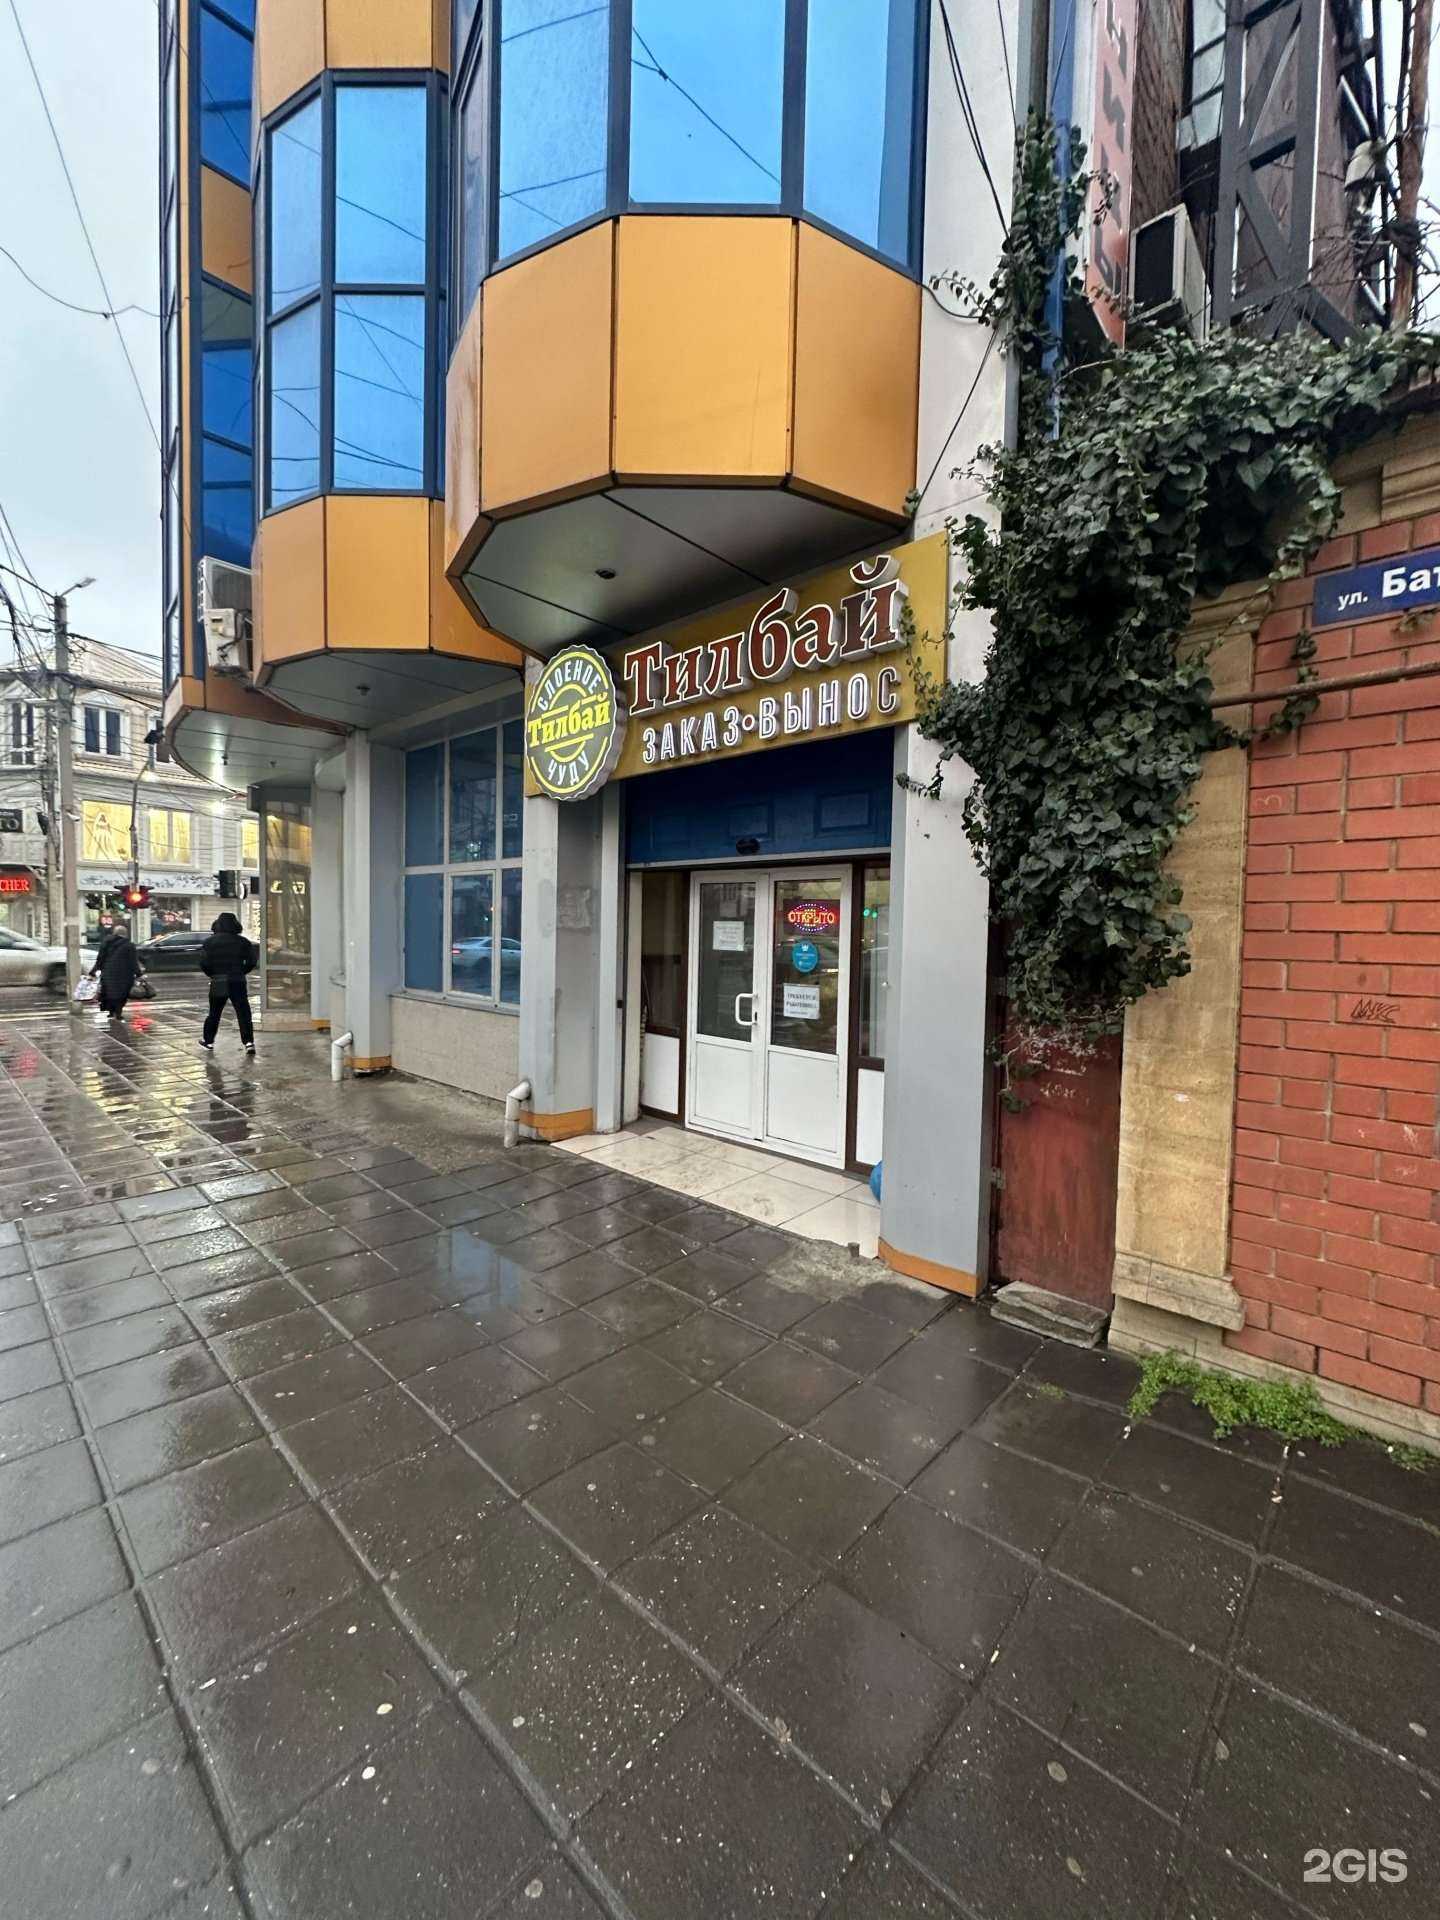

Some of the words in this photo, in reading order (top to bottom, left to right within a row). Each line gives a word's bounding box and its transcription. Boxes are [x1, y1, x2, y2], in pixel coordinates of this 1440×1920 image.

[1337, 591, 1368, 611] ул.
[624, 555, 900, 715] Тилбай
[537, 659, 602, 711] СЛОЕНОЕ
[527, 691, 611, 748] Тилбай
[548, 750, 589, 787] ЧУДУ
[787, 910, 836, 924] ОТКРЫТО
